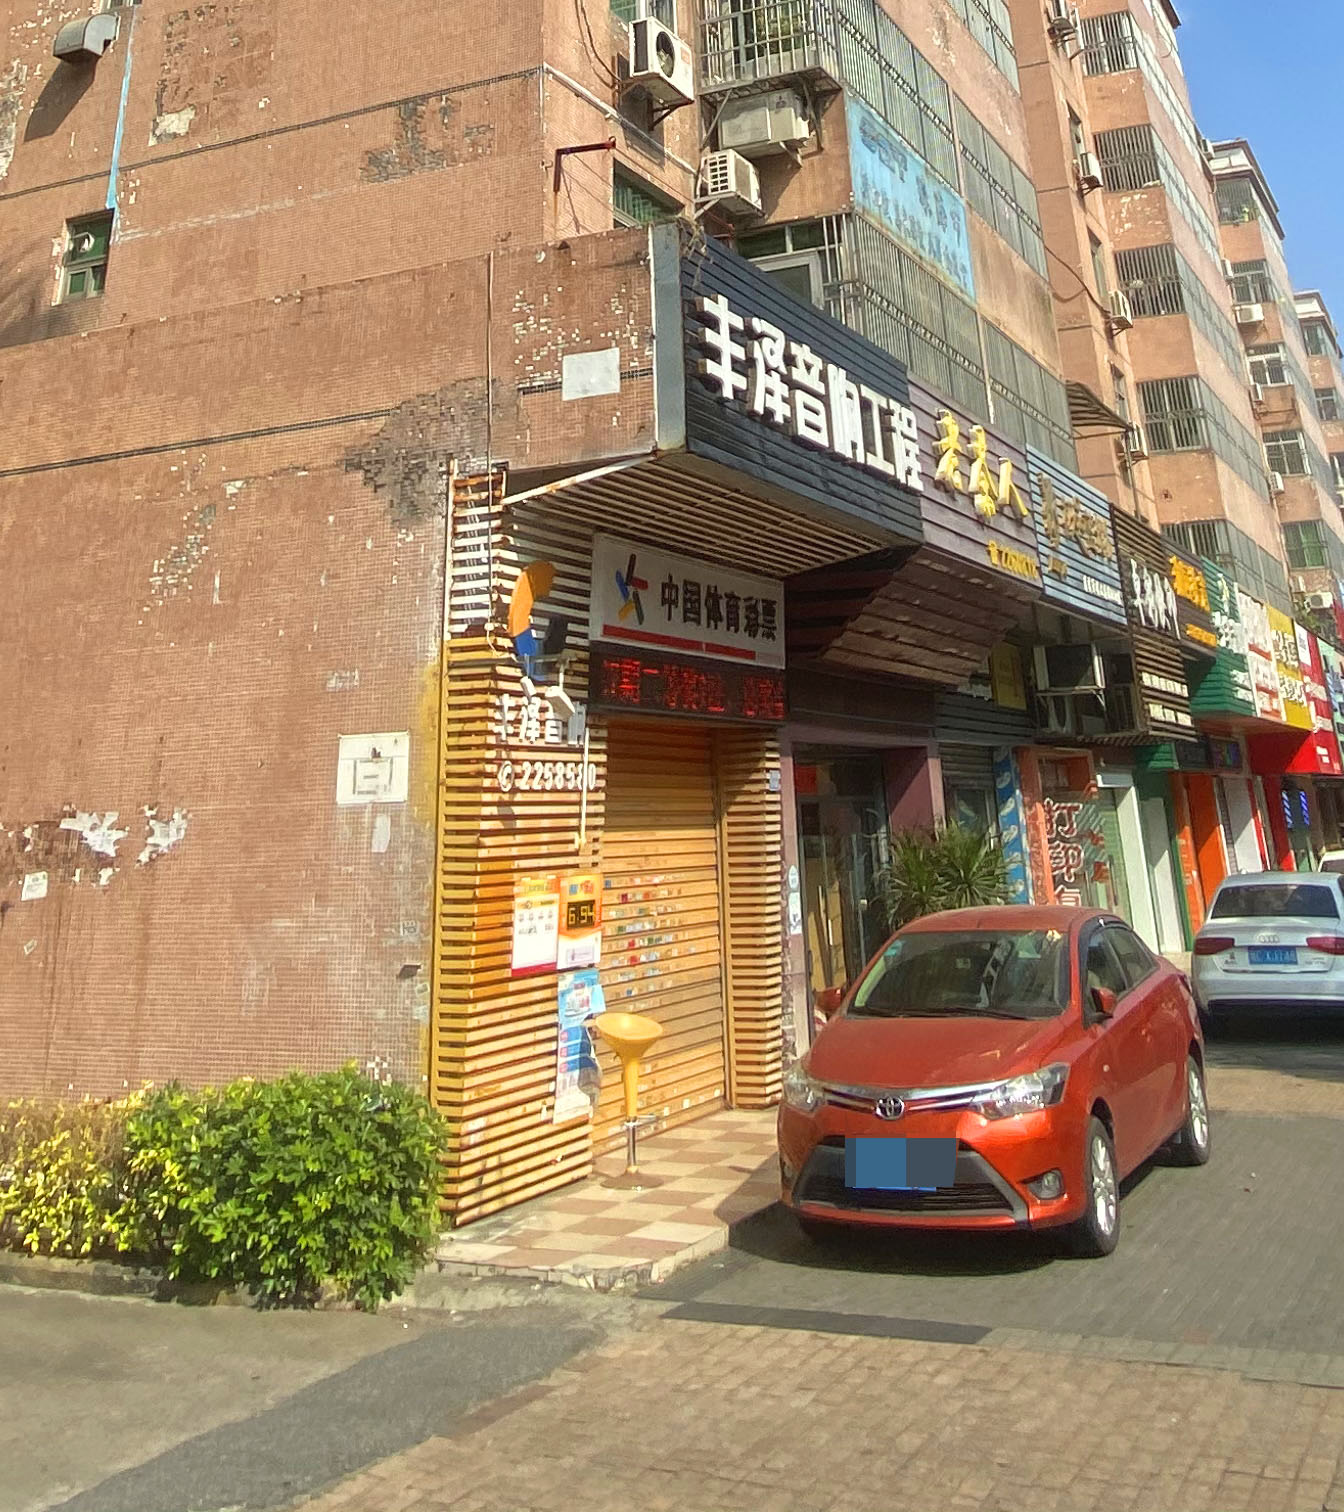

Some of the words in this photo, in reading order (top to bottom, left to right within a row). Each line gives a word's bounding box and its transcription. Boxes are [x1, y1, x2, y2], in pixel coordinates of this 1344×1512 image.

[698, 294, 925, 492] 丰泽音响工程
[660, 572, 778, 642] 中国体育彩票
